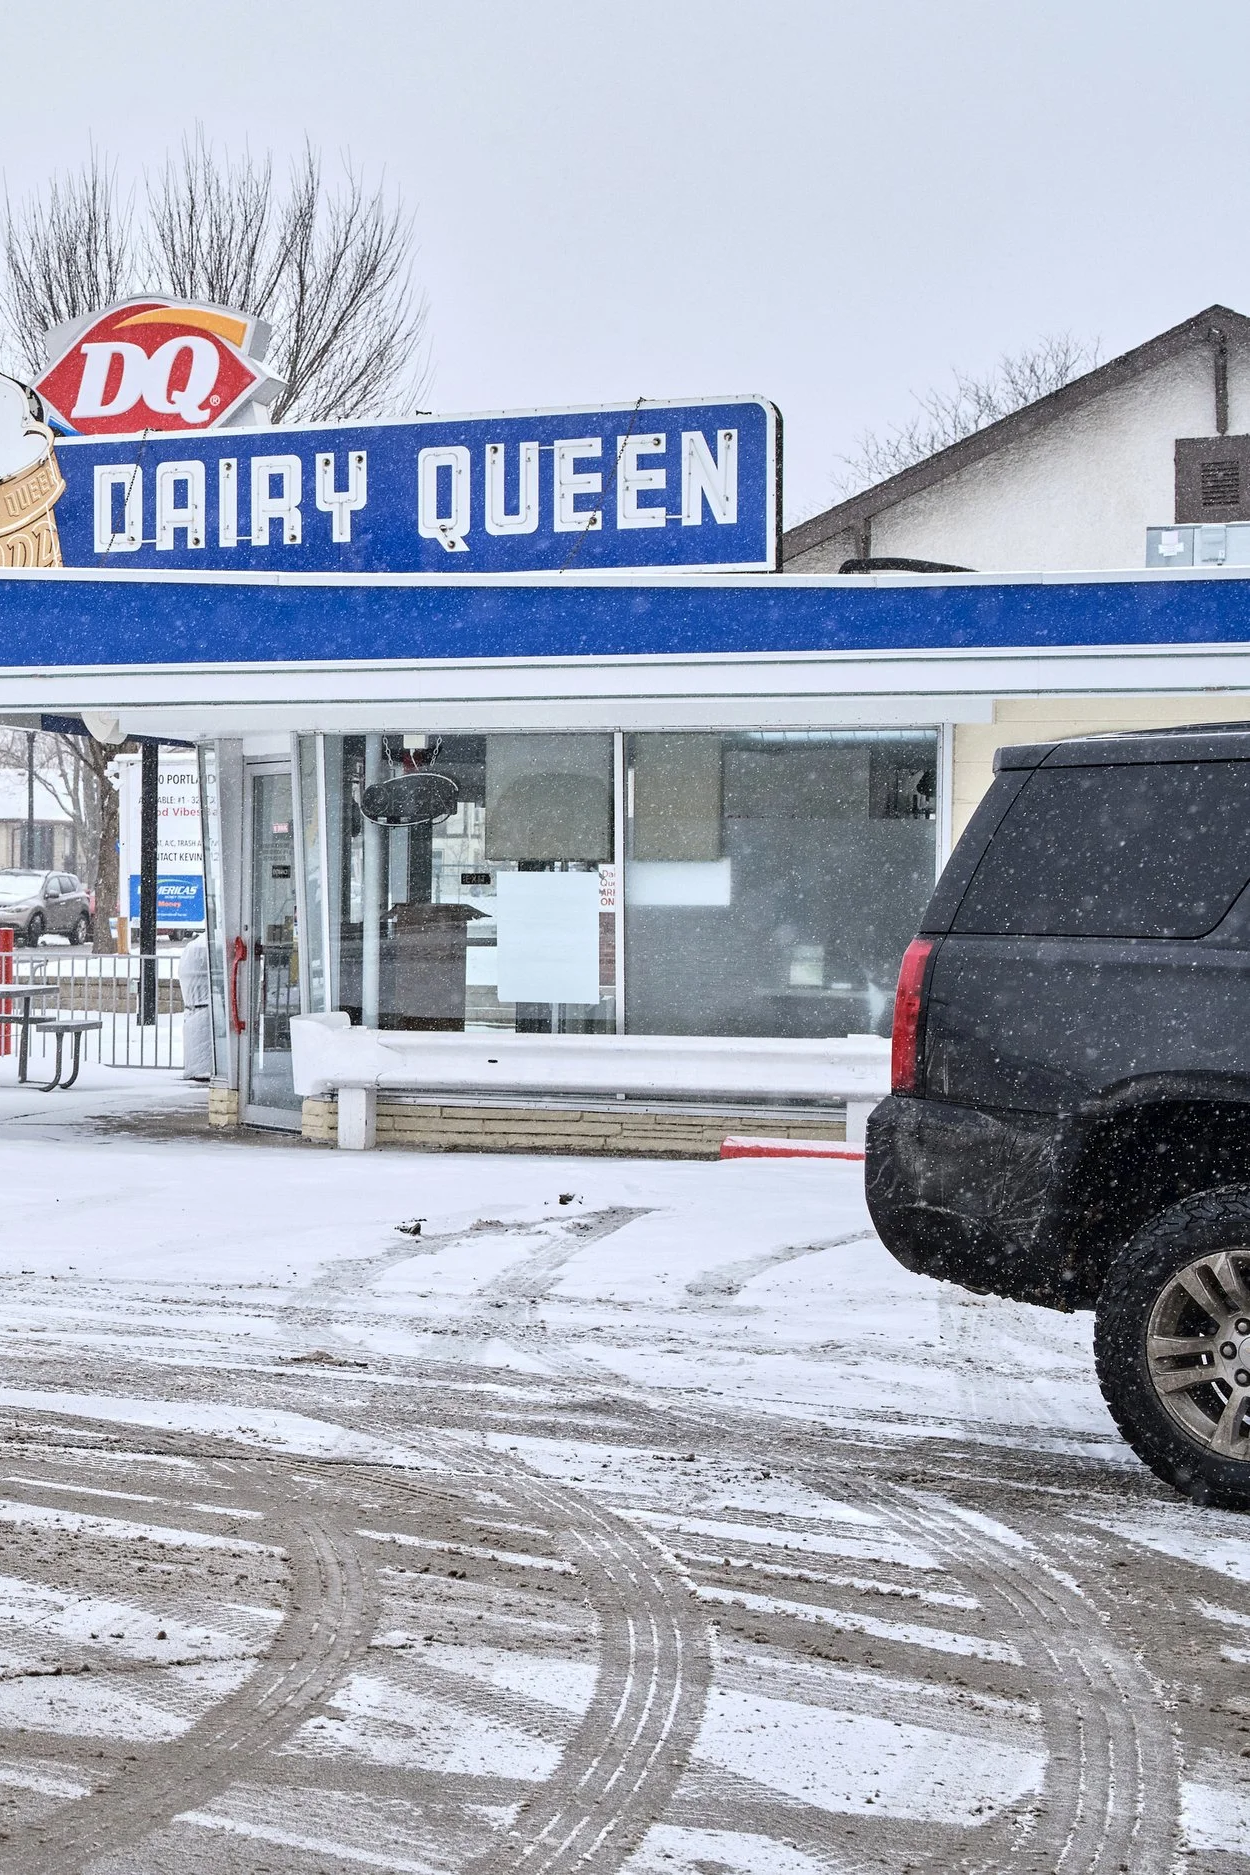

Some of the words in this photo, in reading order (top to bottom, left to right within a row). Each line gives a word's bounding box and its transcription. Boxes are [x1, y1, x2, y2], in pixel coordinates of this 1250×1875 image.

[70, 335, 220, 424] DQ
[92, 450, 368, 554] DAIRY
[417, 428, 739, 553] QUEEN
[172, 808, 201, 816] Vibes
[179, 853, 203, 862] KEVIN
